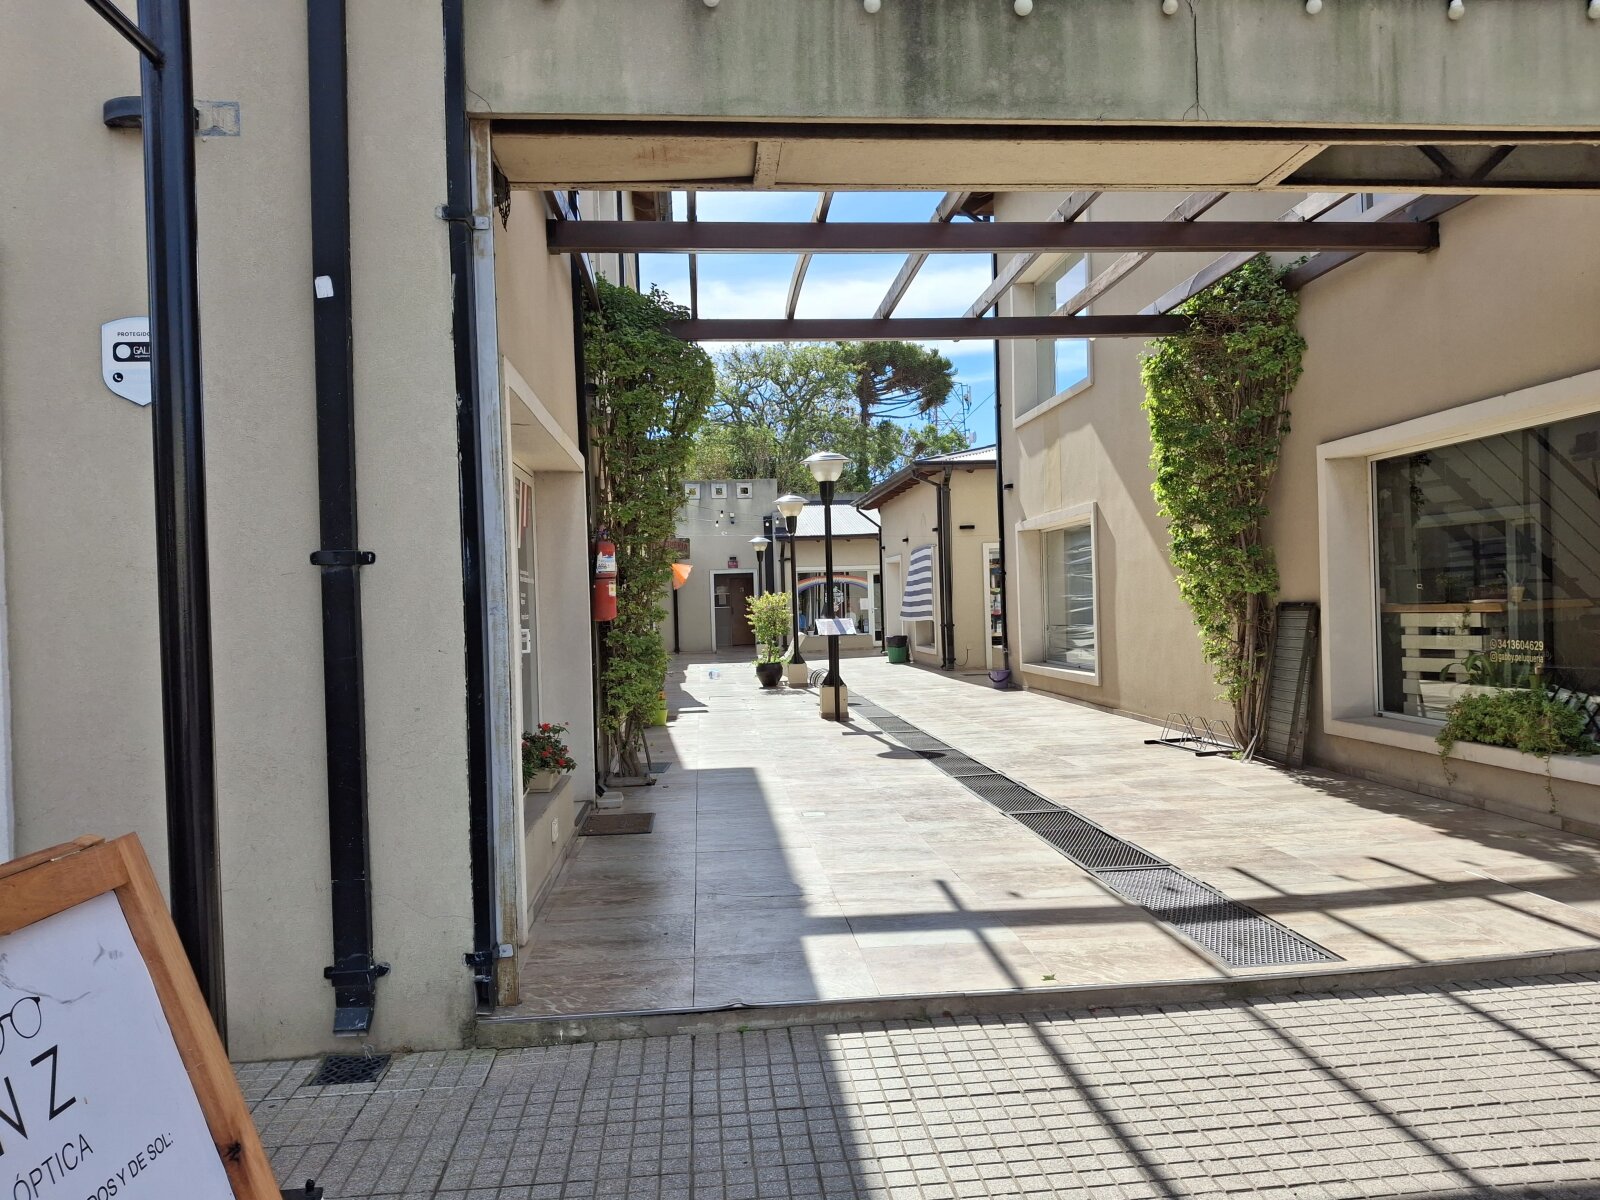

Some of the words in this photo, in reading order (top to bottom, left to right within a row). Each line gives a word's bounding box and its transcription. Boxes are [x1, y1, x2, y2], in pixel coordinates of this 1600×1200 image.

[1497, 639, 1544, 651] 3413604629
[13, 1132, 94, 1200] ÓPTICA
[116, 1167, 126, 1186] Y
[127, 1152, 148, 1178] DE
[146, 1132, 174, 1161] SOL:
